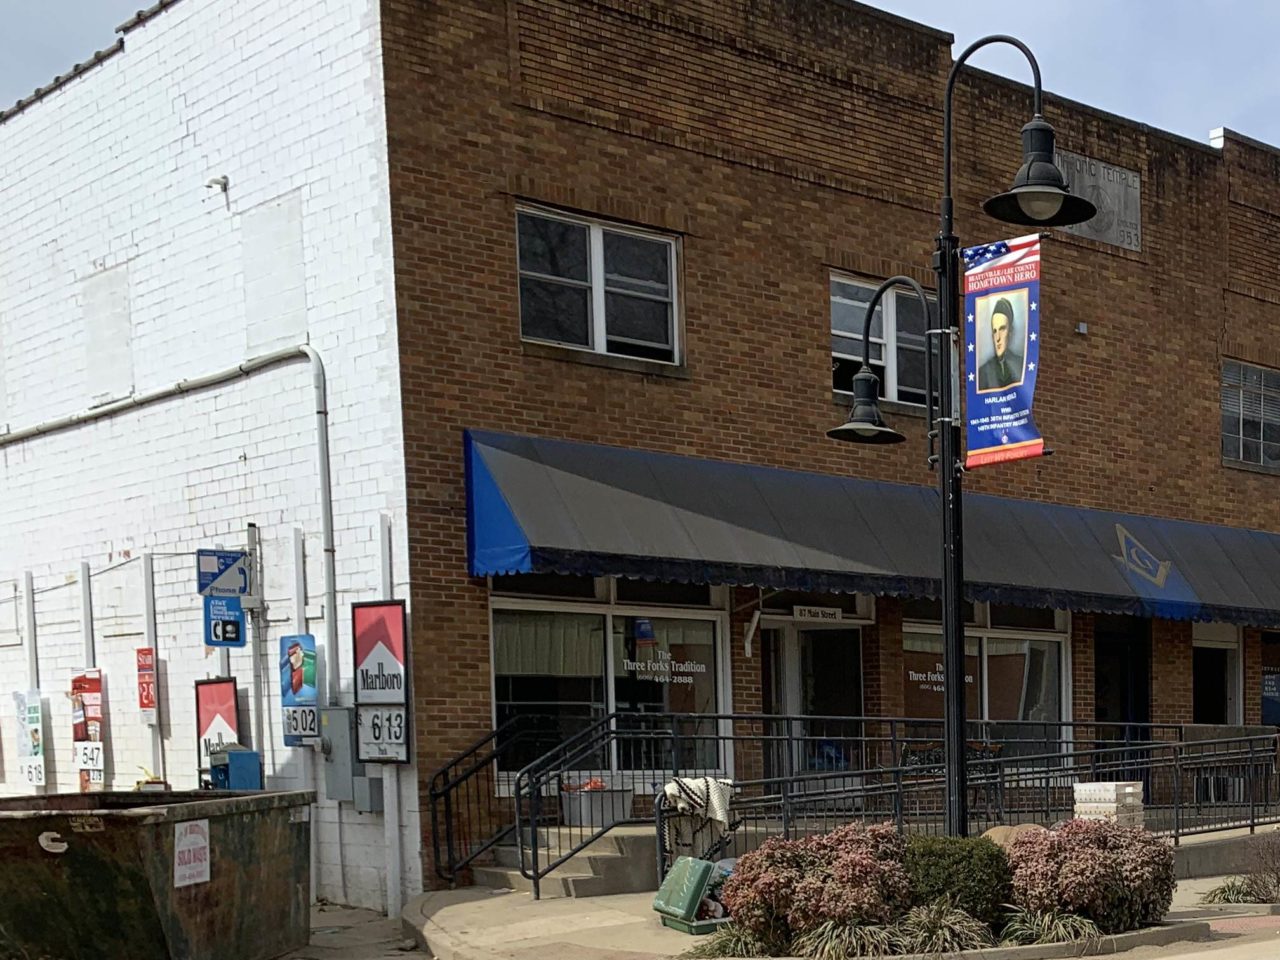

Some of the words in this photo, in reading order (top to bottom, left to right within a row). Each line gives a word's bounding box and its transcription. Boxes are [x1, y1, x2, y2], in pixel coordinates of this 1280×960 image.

[968, 275, 1013, 291] HOMETOWN
[1014, 270, 1036, 282] HERO
[210, 586, 236, 594] Phone
[807, 608, 819, 617] Main
[820, 610, 837, 619] Street
[657, 650, 671, 660] The
[623, 659, 645, 671] Three
[647, 660, 669, 672] Forks
[671, 661, 706, 672] Tradition
[935, 663, 944, 671] Th
[360, 662, 402, 690] Marlboro
[654, 675, 693, 683] 464-2888
[908, 671, 926, 681] Three
[927, 671, 944, 682] Forks
